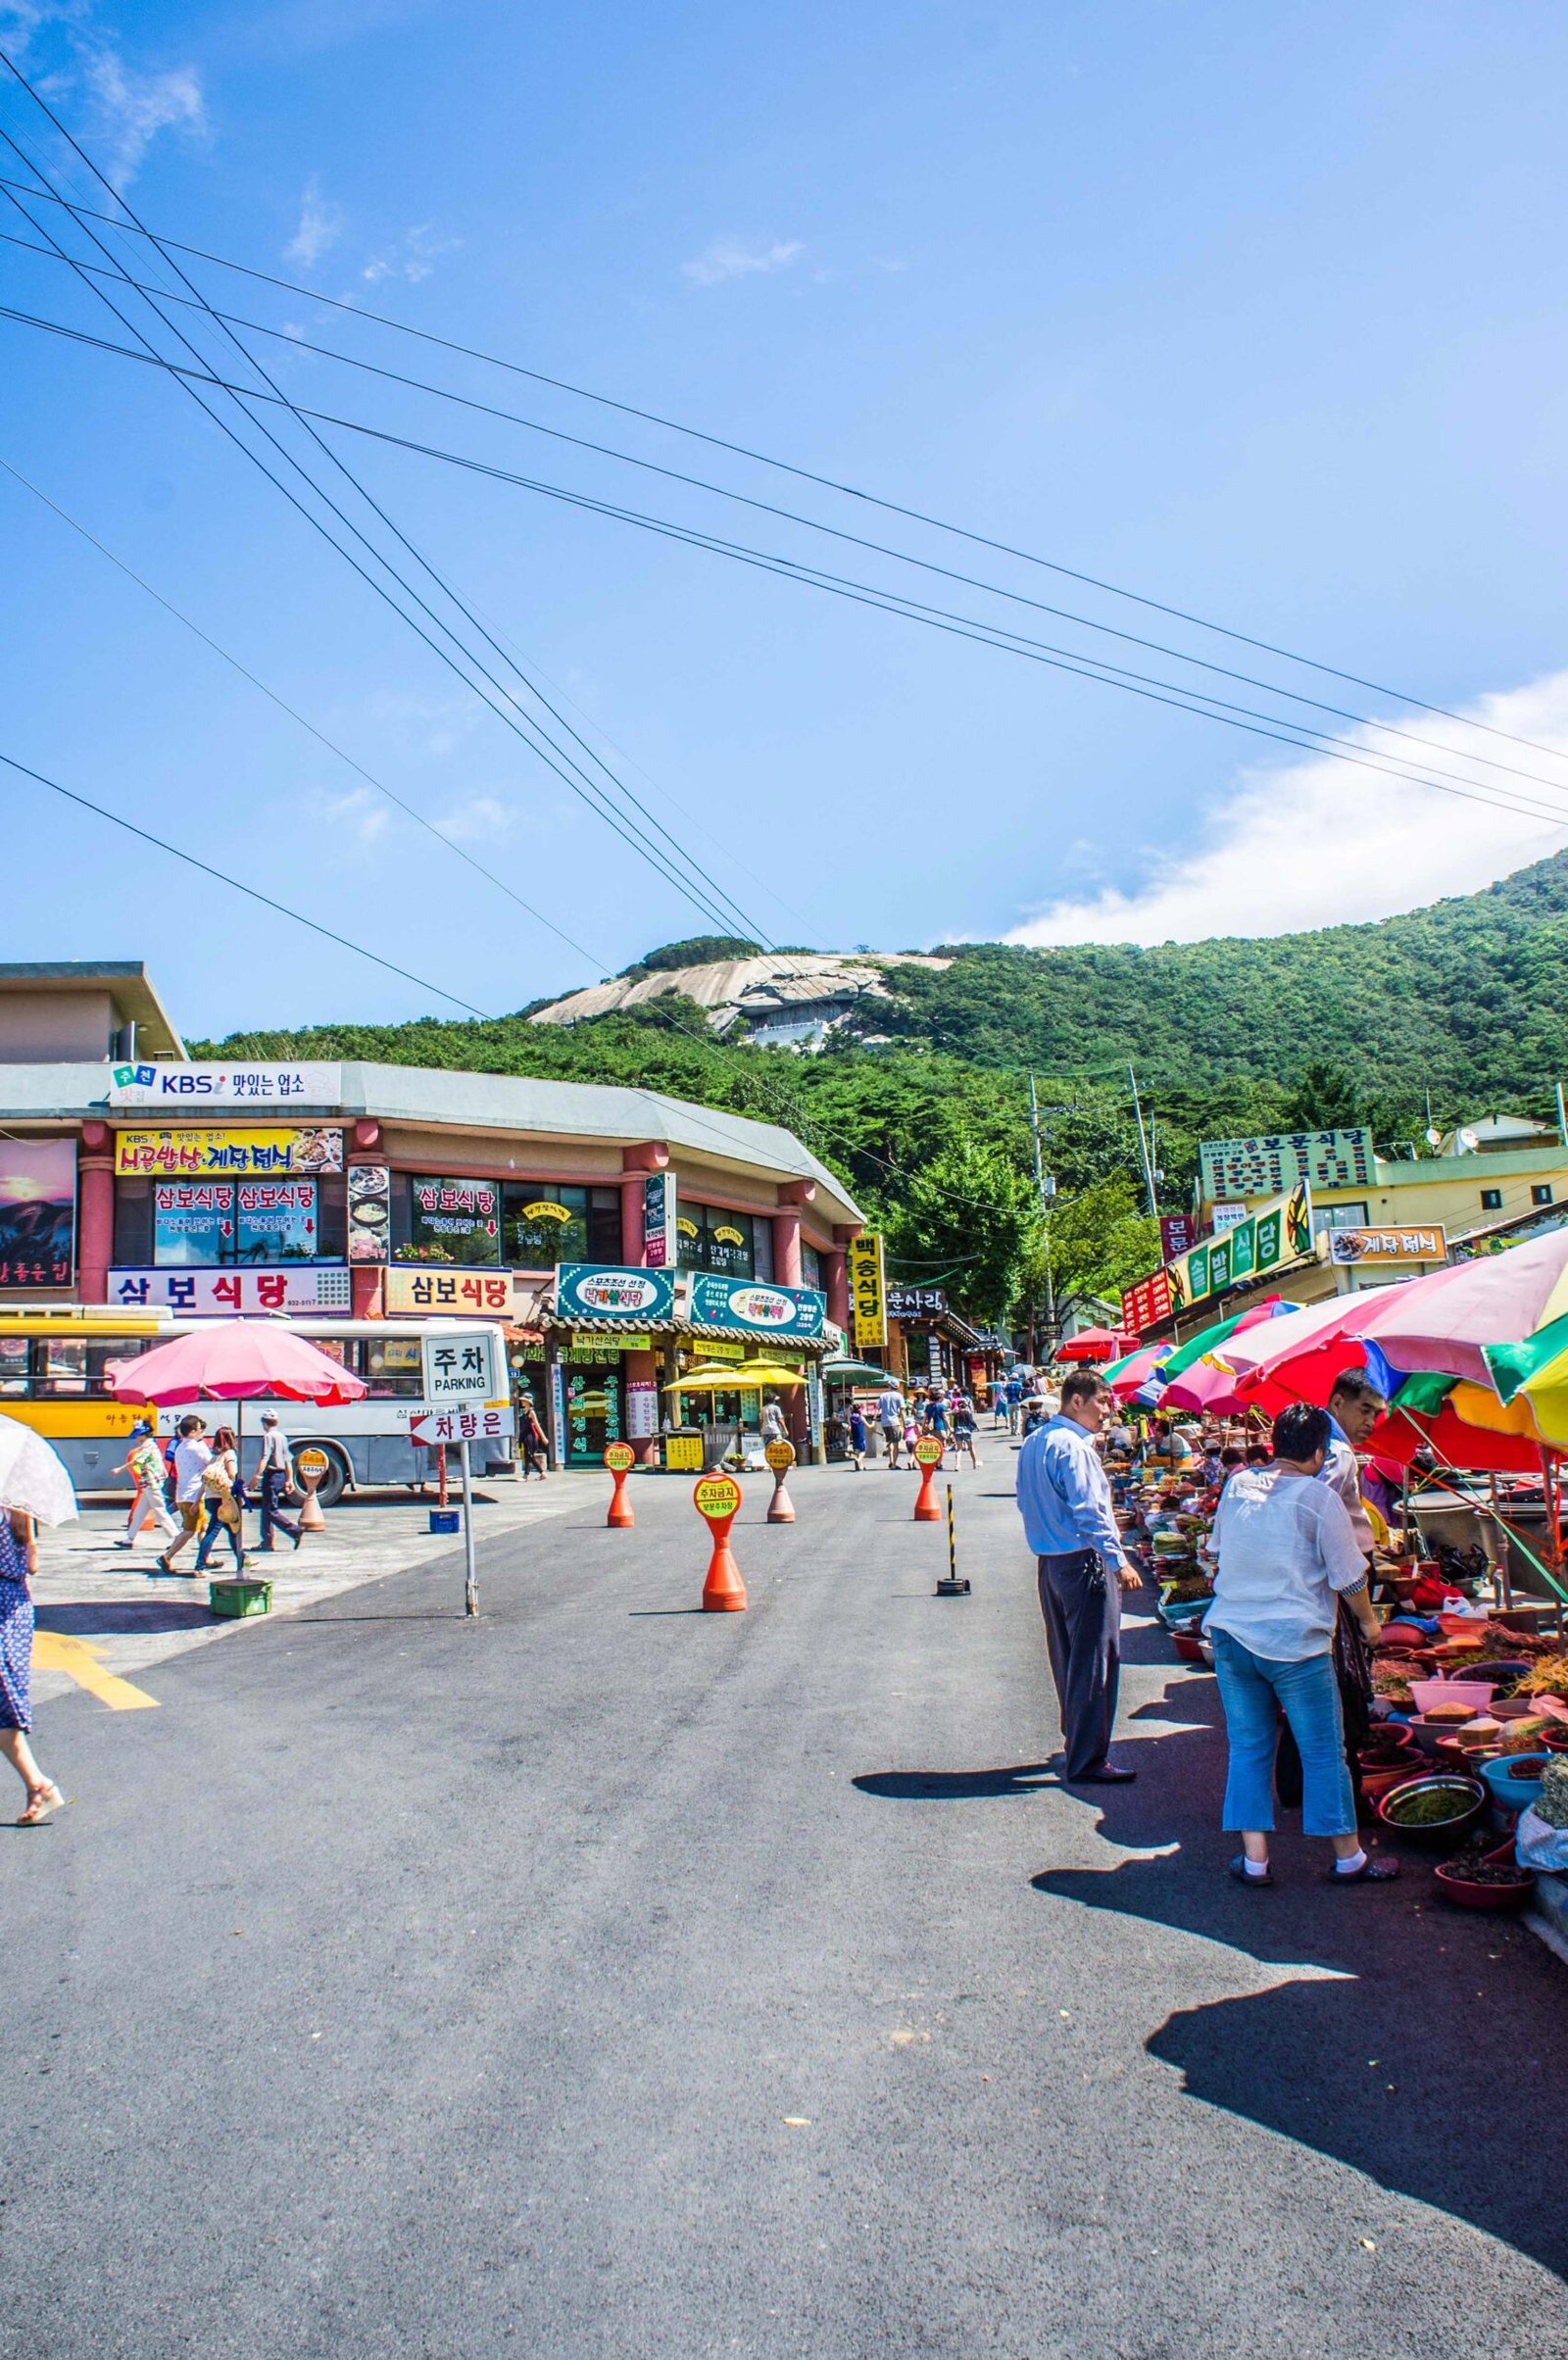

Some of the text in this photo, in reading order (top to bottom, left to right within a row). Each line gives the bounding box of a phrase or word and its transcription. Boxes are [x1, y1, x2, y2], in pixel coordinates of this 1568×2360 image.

[233, 1073, 273, 1096] 맛있는
[277, 1073, 305, 1096] 업소
[177, 1133, 201, 1143] 맛있는
[1261, 1130, 1366, 1151] 보문식당
[157, 1187, 233, 1209] 삼보식당
[239, 1186, 316, 1209] 삼보식당
[419, 1187, 495, 1213] 삼보식당
[588, 1277, 626, 1287] 스포츠조선
[856, 1239, 880, 1317] 백송식당
[118, 1274, 287, 1309] 삼보식당
[412, 1276, 507, 1307] 삼보식당
[585, 1288, 642, 1306] 낙가산식당
[434, 1346, 485, 1376] 주차
[434, 1376, 486, 1391] PARKING
[436, 1412, 501, 1440] 차량은
[701, 1487, 733, 1499] 주차금지
